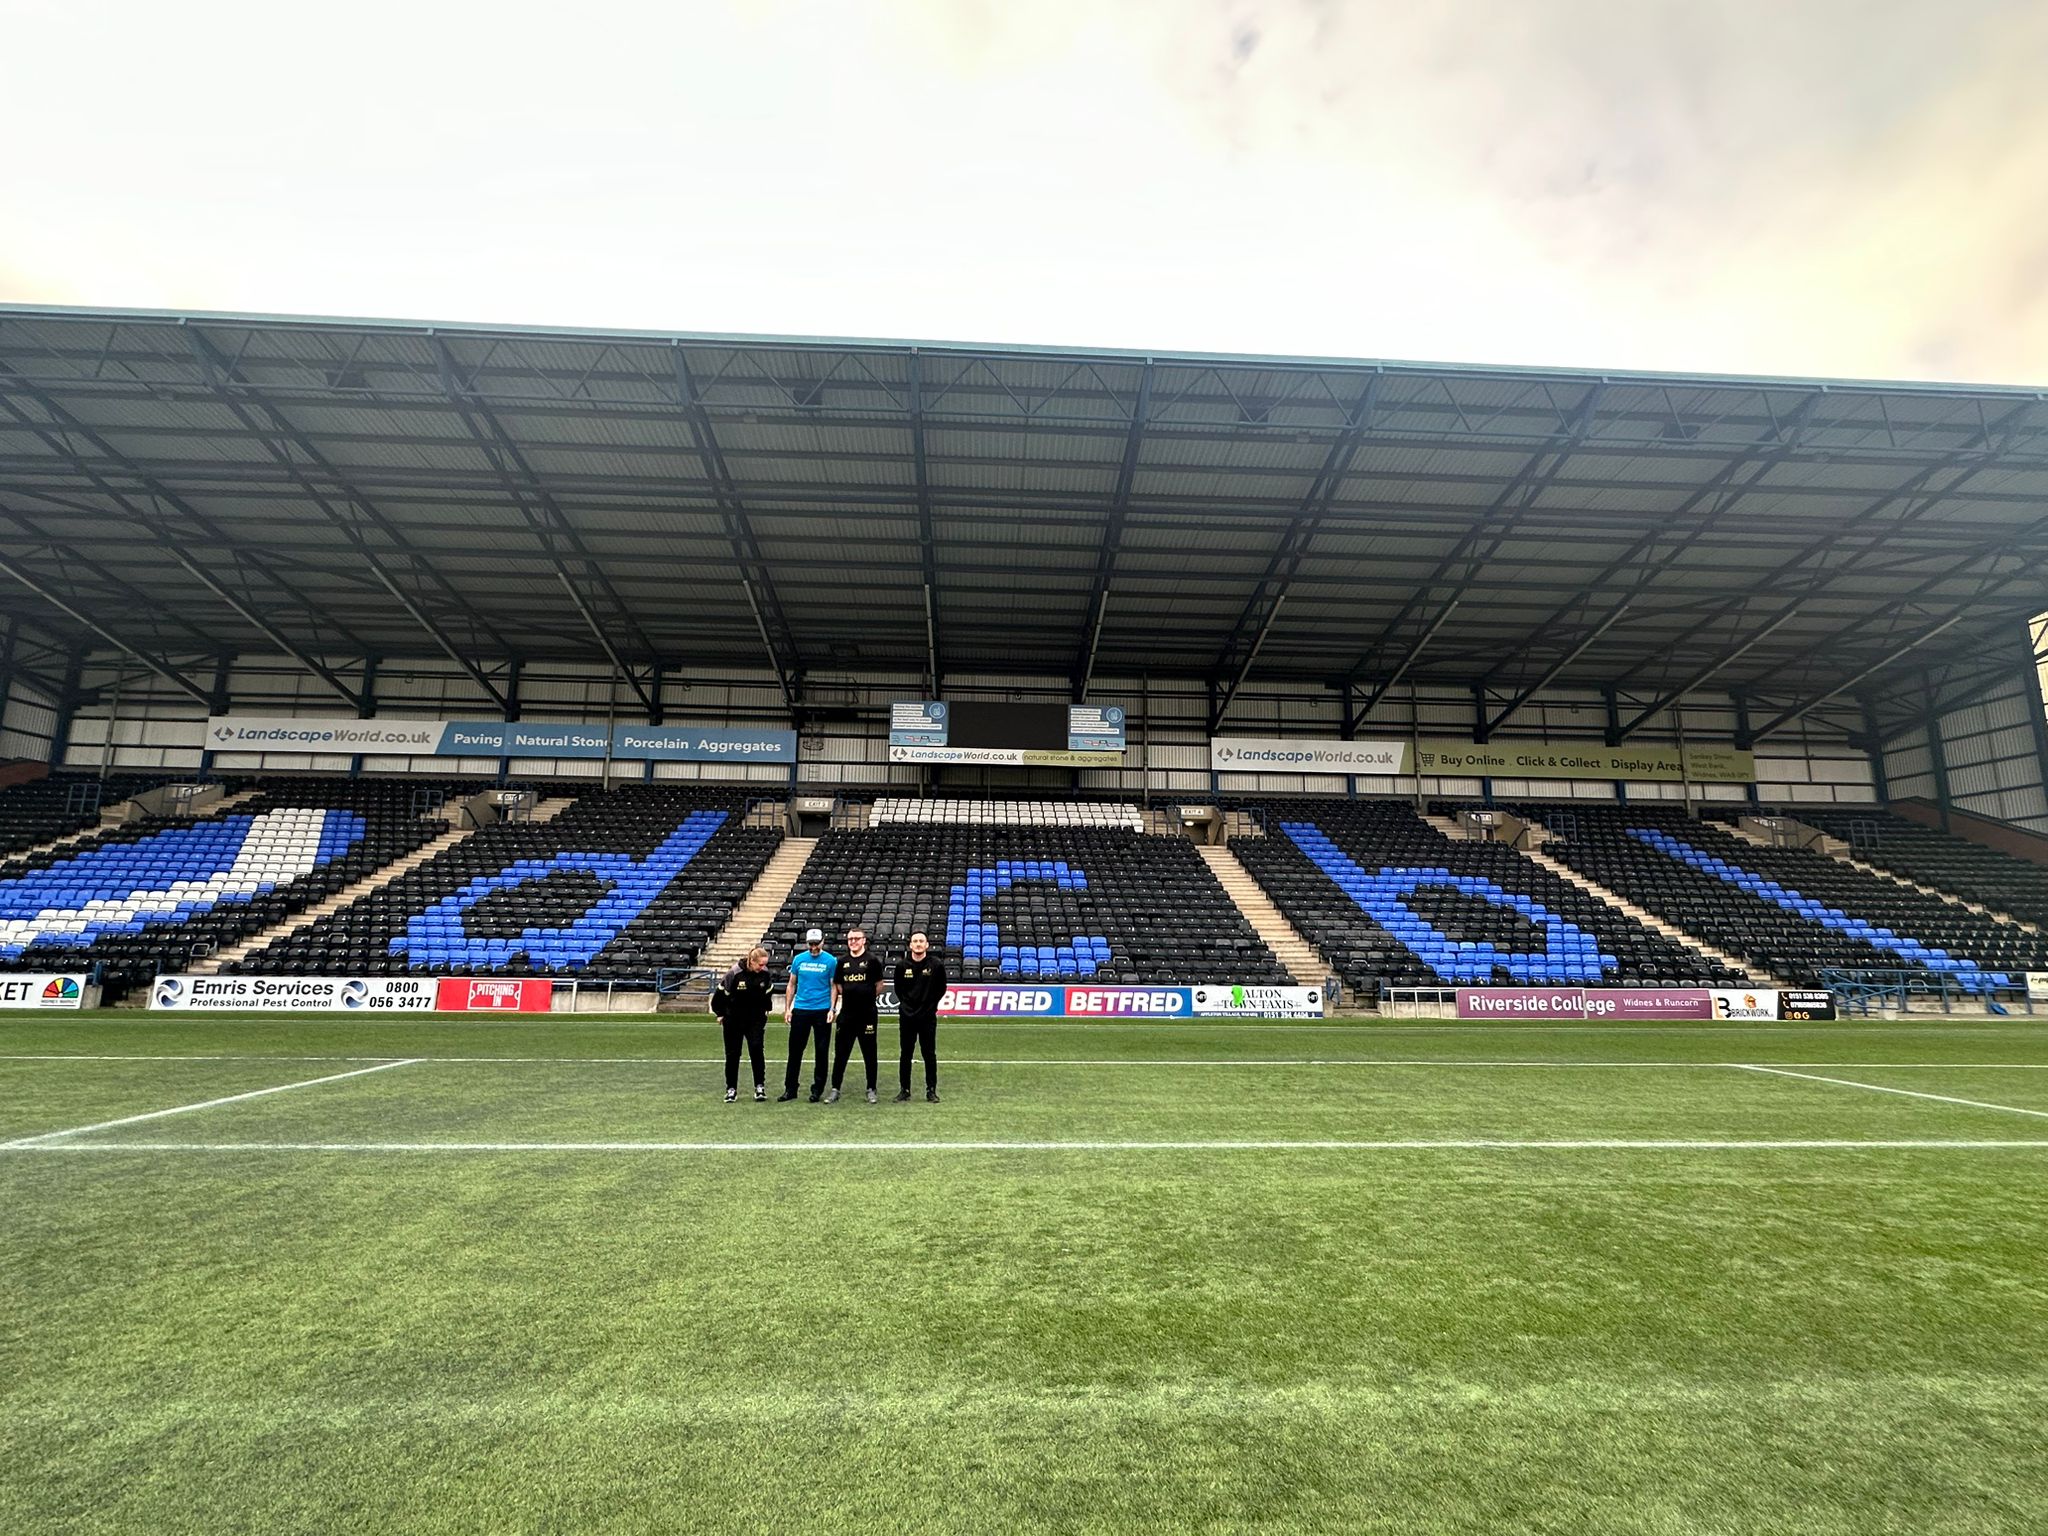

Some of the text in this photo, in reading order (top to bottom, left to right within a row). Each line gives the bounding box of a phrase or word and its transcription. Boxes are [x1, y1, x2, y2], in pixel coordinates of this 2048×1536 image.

[237, 726, 431, 745] LandscapeWorld.co.uk
[454, 733, 503, 747] Paving
[515, 735, 568, 747] Natural
[625, 737, 689, 750] Porcelain
[698, 739, 782, 753] Aggregates
[911, 750, 1017, 762] LandscapeWorld.co.uk
[1237, 748, 1393, 764] LandscapeWorld.co.uk
[1440, 755, 1463, 768] Buy
[1465, 755, 1505, 767] Online
[1516, 756, 1545, 767] Click
[1548, 757, 1557, 767] &
[1560, 757, 1601, 769] Collect
[1611, 758, 1653, 772] Display
[192, 980, 334, 996] Emris Services
[386, 982, 419, 993] 0800
[477, 983, 515, 997] PITCHING
[190, 998, 333, 1007] Professional Pest Control
[369, 996, 431, 1008] 056 3477
[492, 995, 502, 1007] IN
[937, 990, 1053, 1012] BETFRED
[1069, 991, 1184, 1014] BETFRED
[1259, 999, 1294, 1010] TAXIS
[1469, 995, 1616, 1016] Riverside College
[1623, 998, 1699, 1008] Widnes & Runcorn
